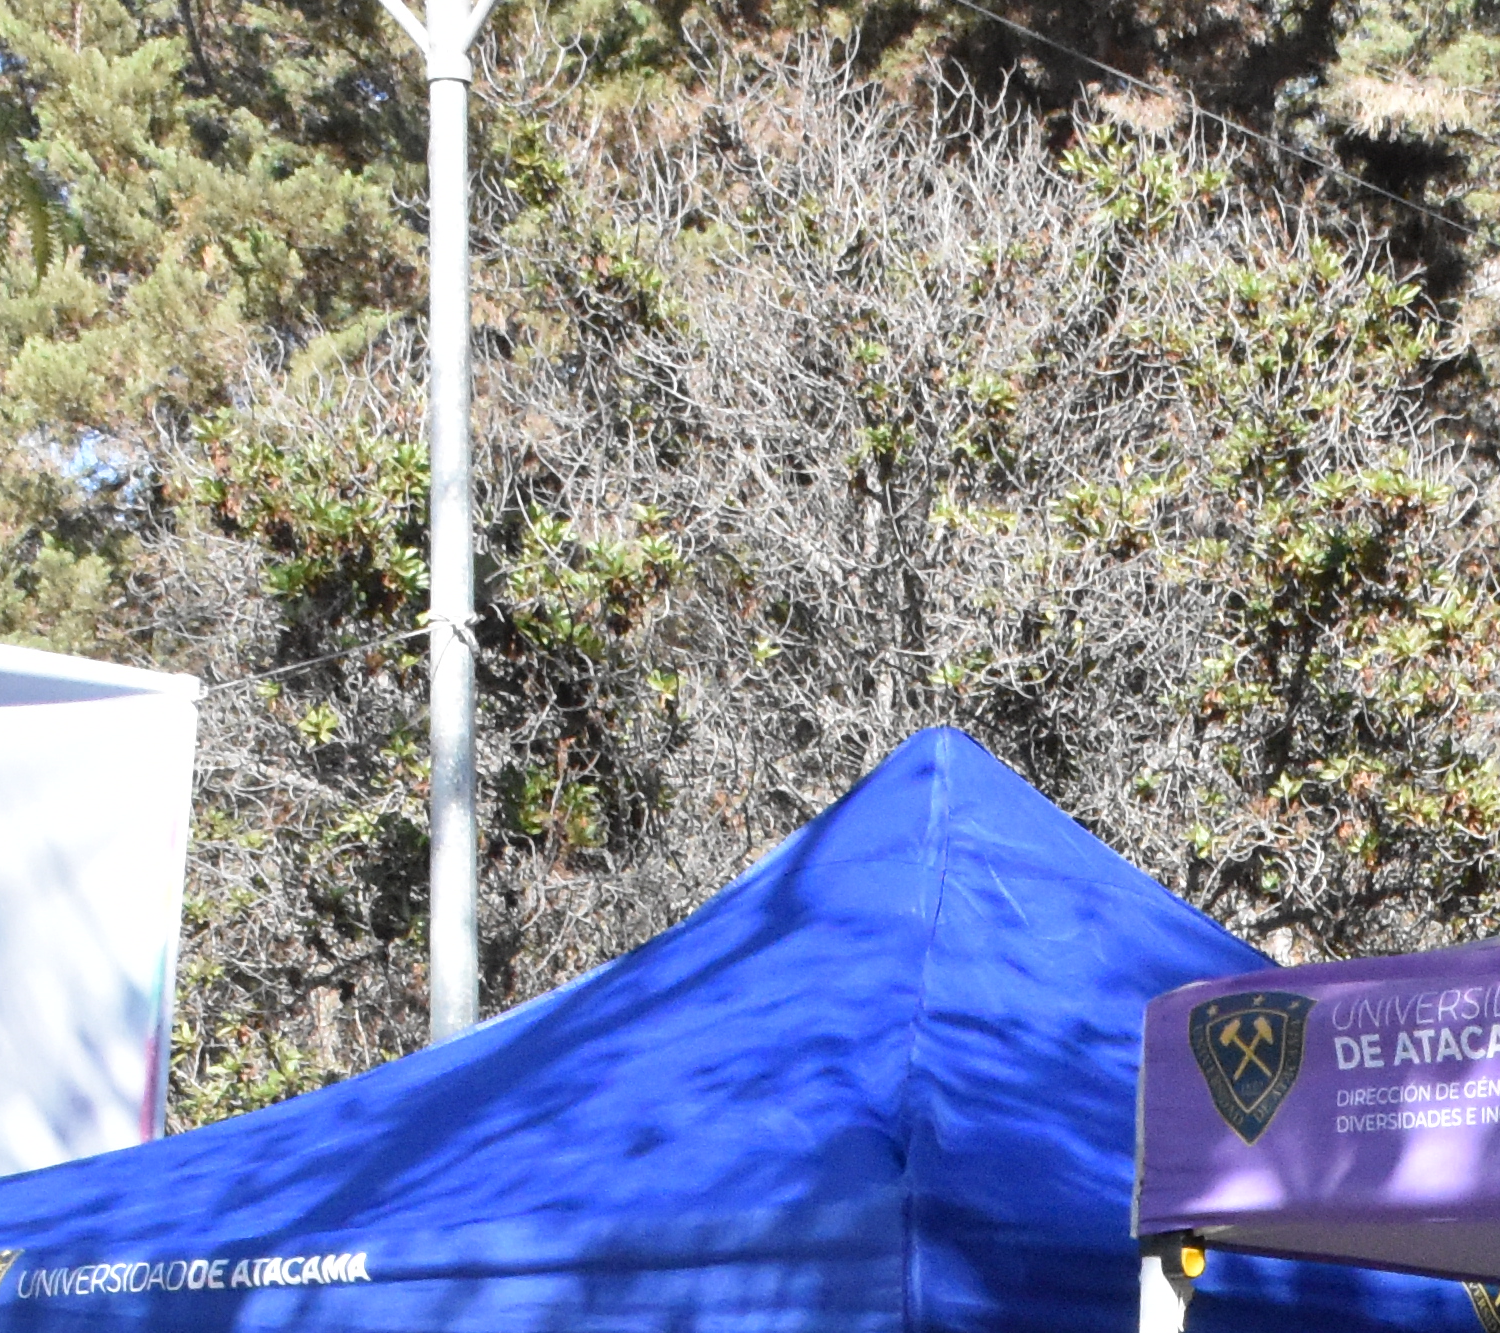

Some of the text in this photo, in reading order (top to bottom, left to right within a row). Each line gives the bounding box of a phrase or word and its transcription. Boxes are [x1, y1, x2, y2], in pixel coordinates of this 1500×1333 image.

[1334, 1034, 1385, 1070] DE
[1337, 1082, 1431, 1108] DIRECCIÓN
[1435, 1082, 1460, 1100] DE
[1337, 1106, 1463, 1132] DIVERSIDADES
[1466, 1108, 1478, 1125] E
[17, 1252, 372, 1300] UNIVERSIDAD DE ATACAMA
